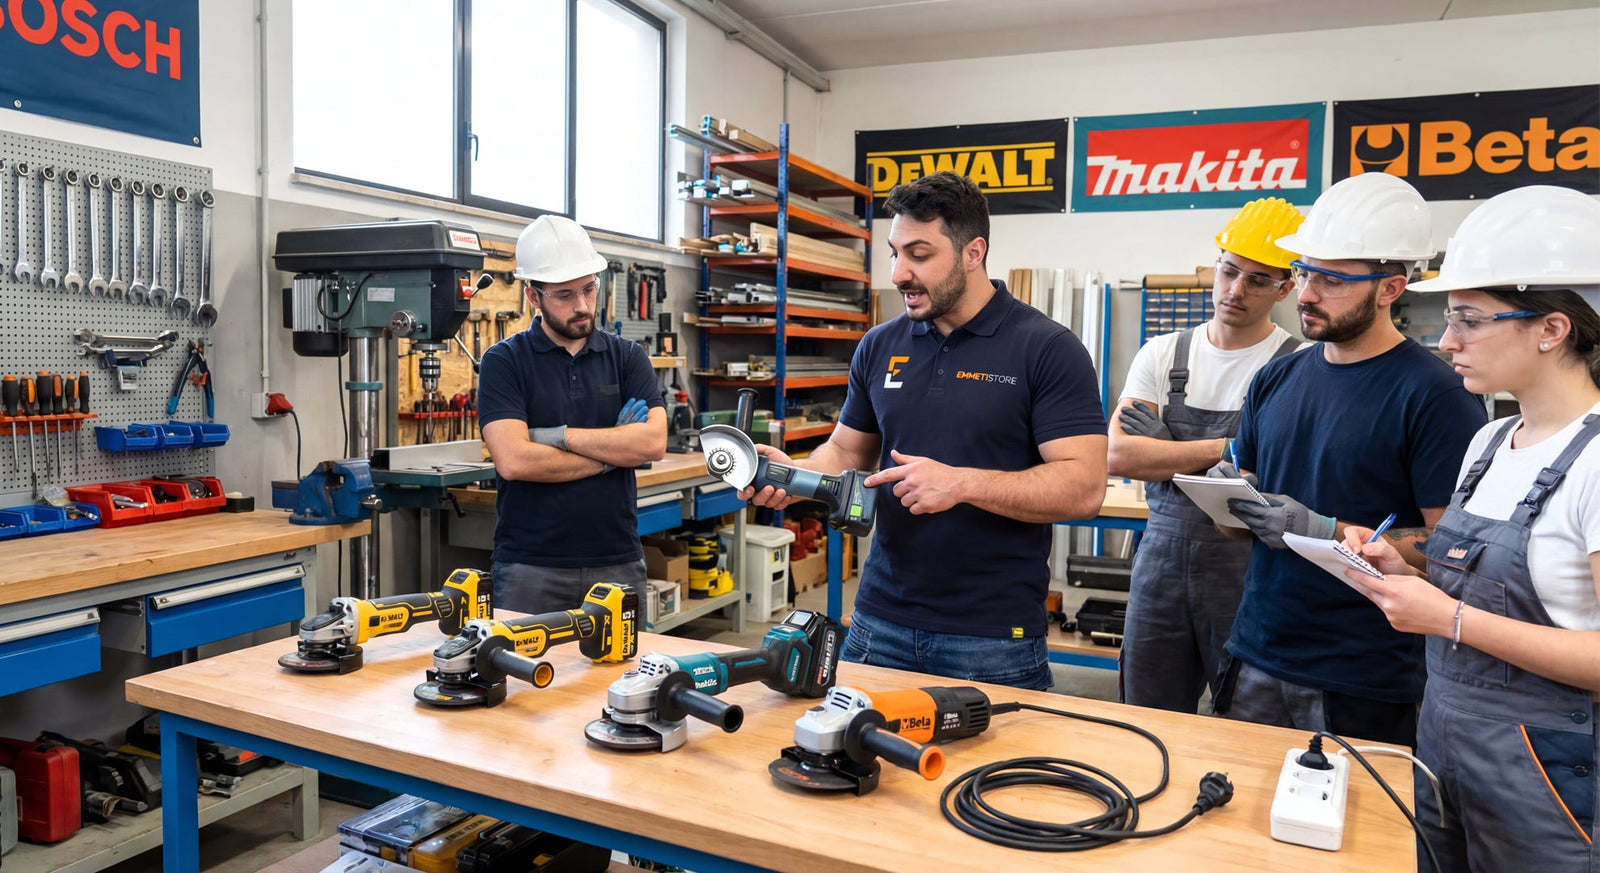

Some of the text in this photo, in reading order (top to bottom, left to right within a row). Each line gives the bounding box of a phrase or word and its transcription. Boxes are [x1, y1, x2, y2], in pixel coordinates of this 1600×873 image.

[0, 0, 181, 80] OSCH
[1418, 117, 1600, 176] Beta
[956, 371, 1018, 385] EMMETISTORE
[909, 716, 931, 728] Beta
